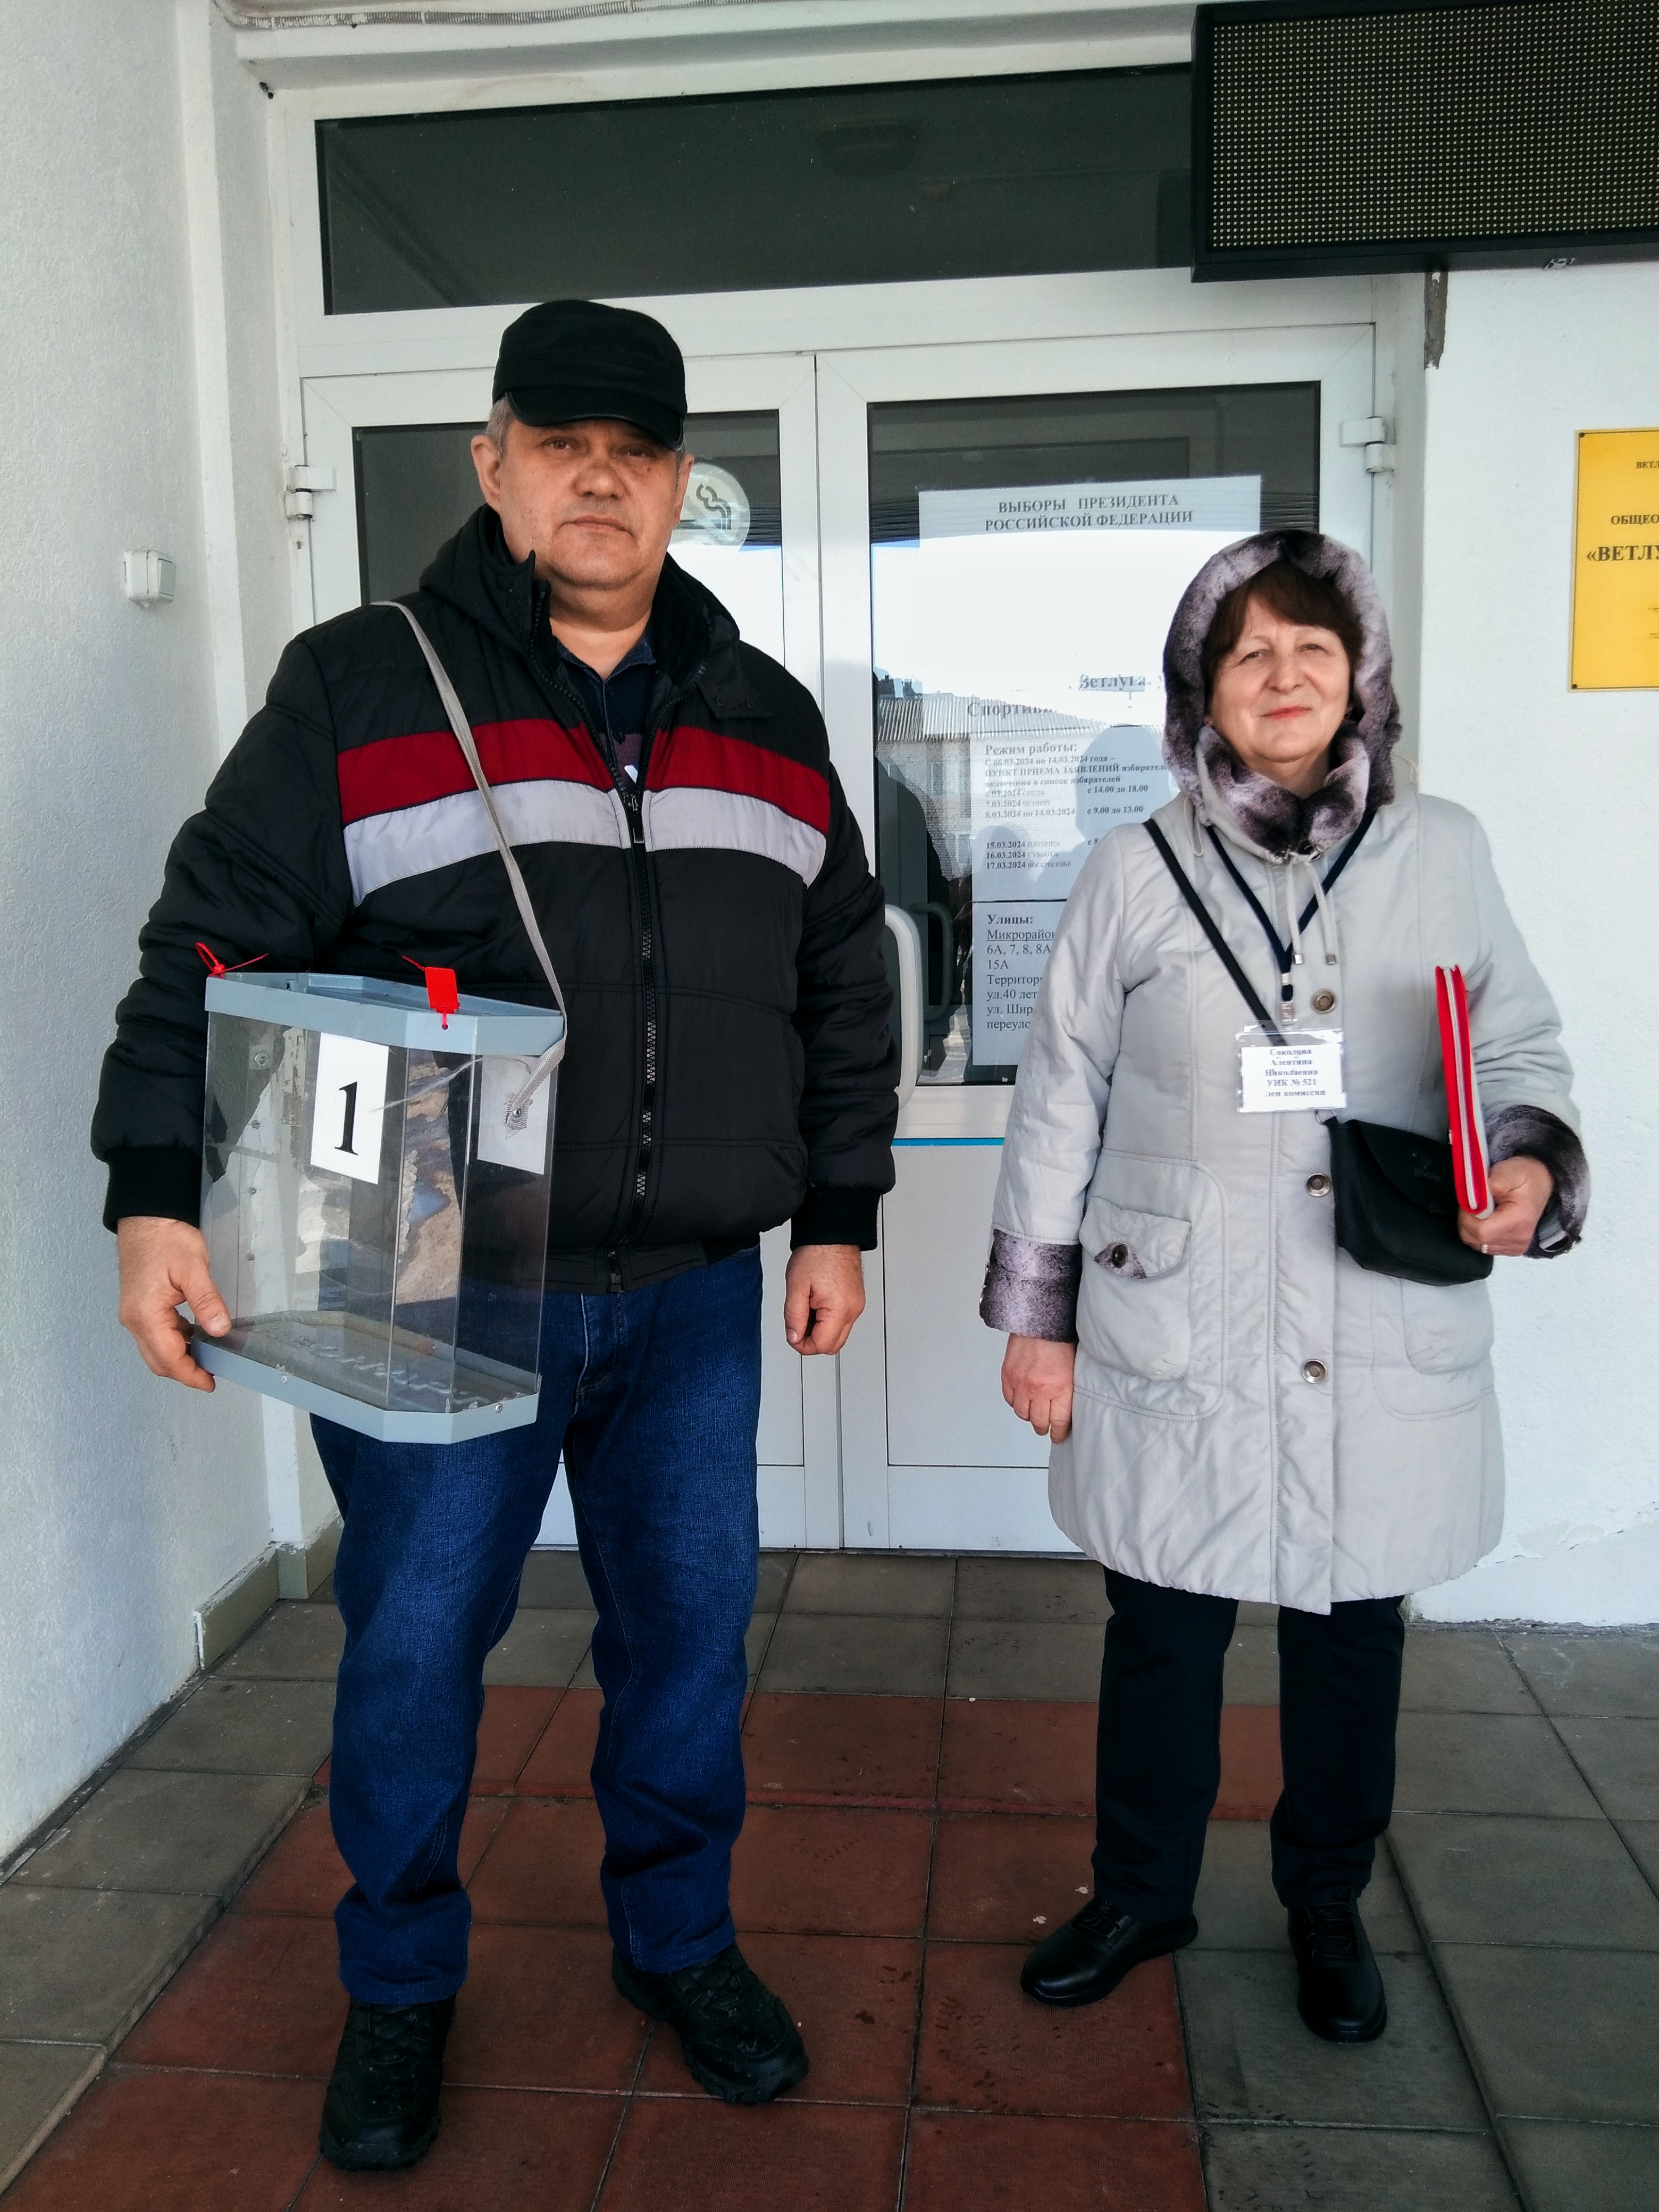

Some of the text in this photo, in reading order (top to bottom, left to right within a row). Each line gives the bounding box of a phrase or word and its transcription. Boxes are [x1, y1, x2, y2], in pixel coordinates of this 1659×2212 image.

[999, 495, 1178, 513] ВЫБОРЫ ПРЕЗИДЕНТА
[985, 510, 1192, 531] РОССИЙСКОЙ ФЕДЕРАЦИИ
[1611, 514, 1659, 525] ОБЩЕО
[985, 743, 1077, 756] Режим работы:
[993, 758, 1033, 766] 06.03.2024
[985, 768, 1018, 777] ПУНКТ
[1062, 764, 1119, 773] ЗАЯВЛЕНИЙ
[1070, 775, 1120, 784] избирателей
[985, 810, 1021, 819] 8.03.2024
[1035, 808, 1075, 817] 14.03.2024
[986, 841, 1025, 849] 15.03.2024
[987, 915, 1033, 925] Улицы:
[986, 944, 1051, 956] 6А, 7, 8, 8А
[988, 960, 1009, 969] 15А
[986, 974, 1042, 987] Территор
[987, 1004, 1033, 1017] ул. Шир
[334, 1081, 358, 1155] 1
